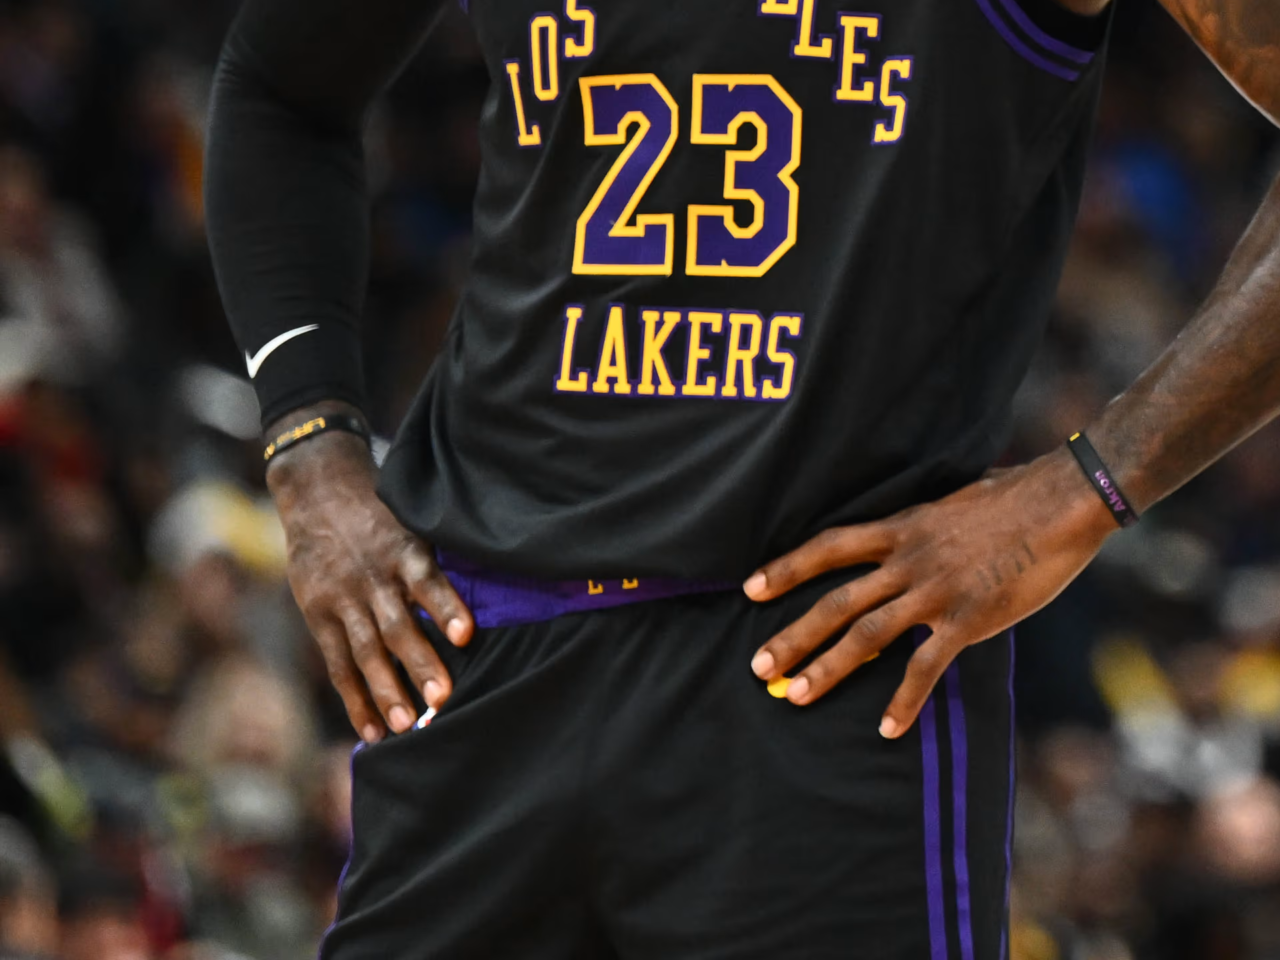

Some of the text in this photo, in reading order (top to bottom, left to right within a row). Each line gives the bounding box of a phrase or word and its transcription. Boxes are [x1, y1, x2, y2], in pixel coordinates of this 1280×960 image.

[571, 73, 803, 278] 23
[554, 303, 803, 401] LAKERS
[1094, 469, 1127, 512] Akron
